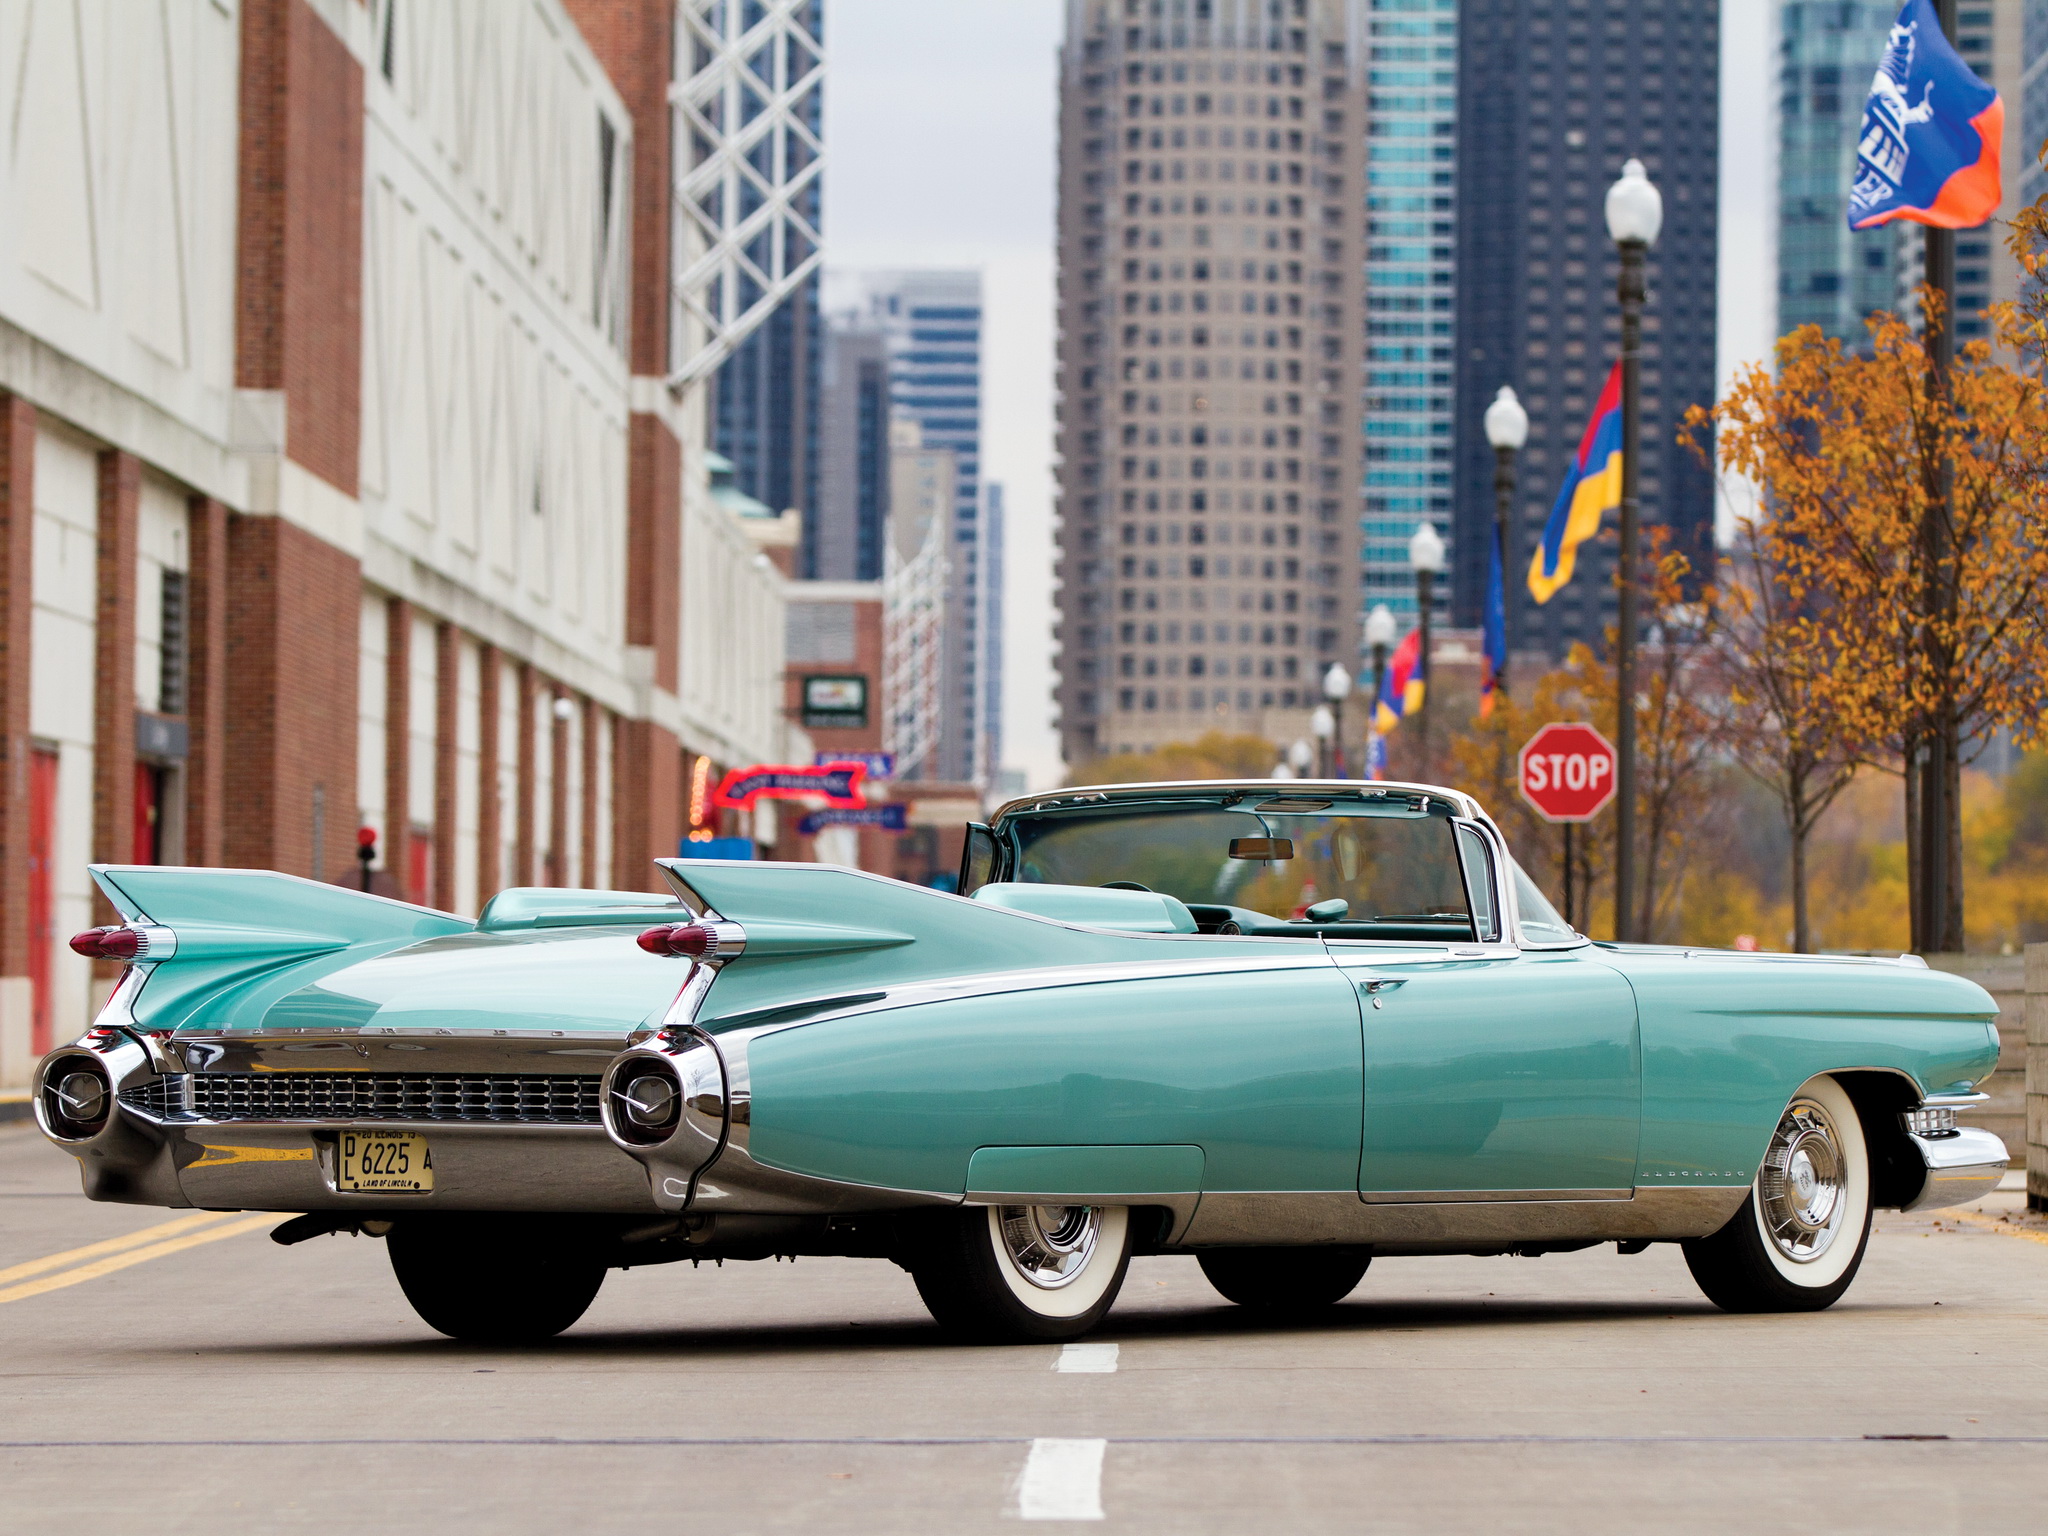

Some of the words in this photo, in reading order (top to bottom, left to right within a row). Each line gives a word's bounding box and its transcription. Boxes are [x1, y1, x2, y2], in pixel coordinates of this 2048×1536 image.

[1526, 753, 1610, 791] STOP
[375, 1131, 403, 1139] ILLINOIS
[362, 1143, 409, 1174] 6225
[423, 1147, 432, 1169] A
